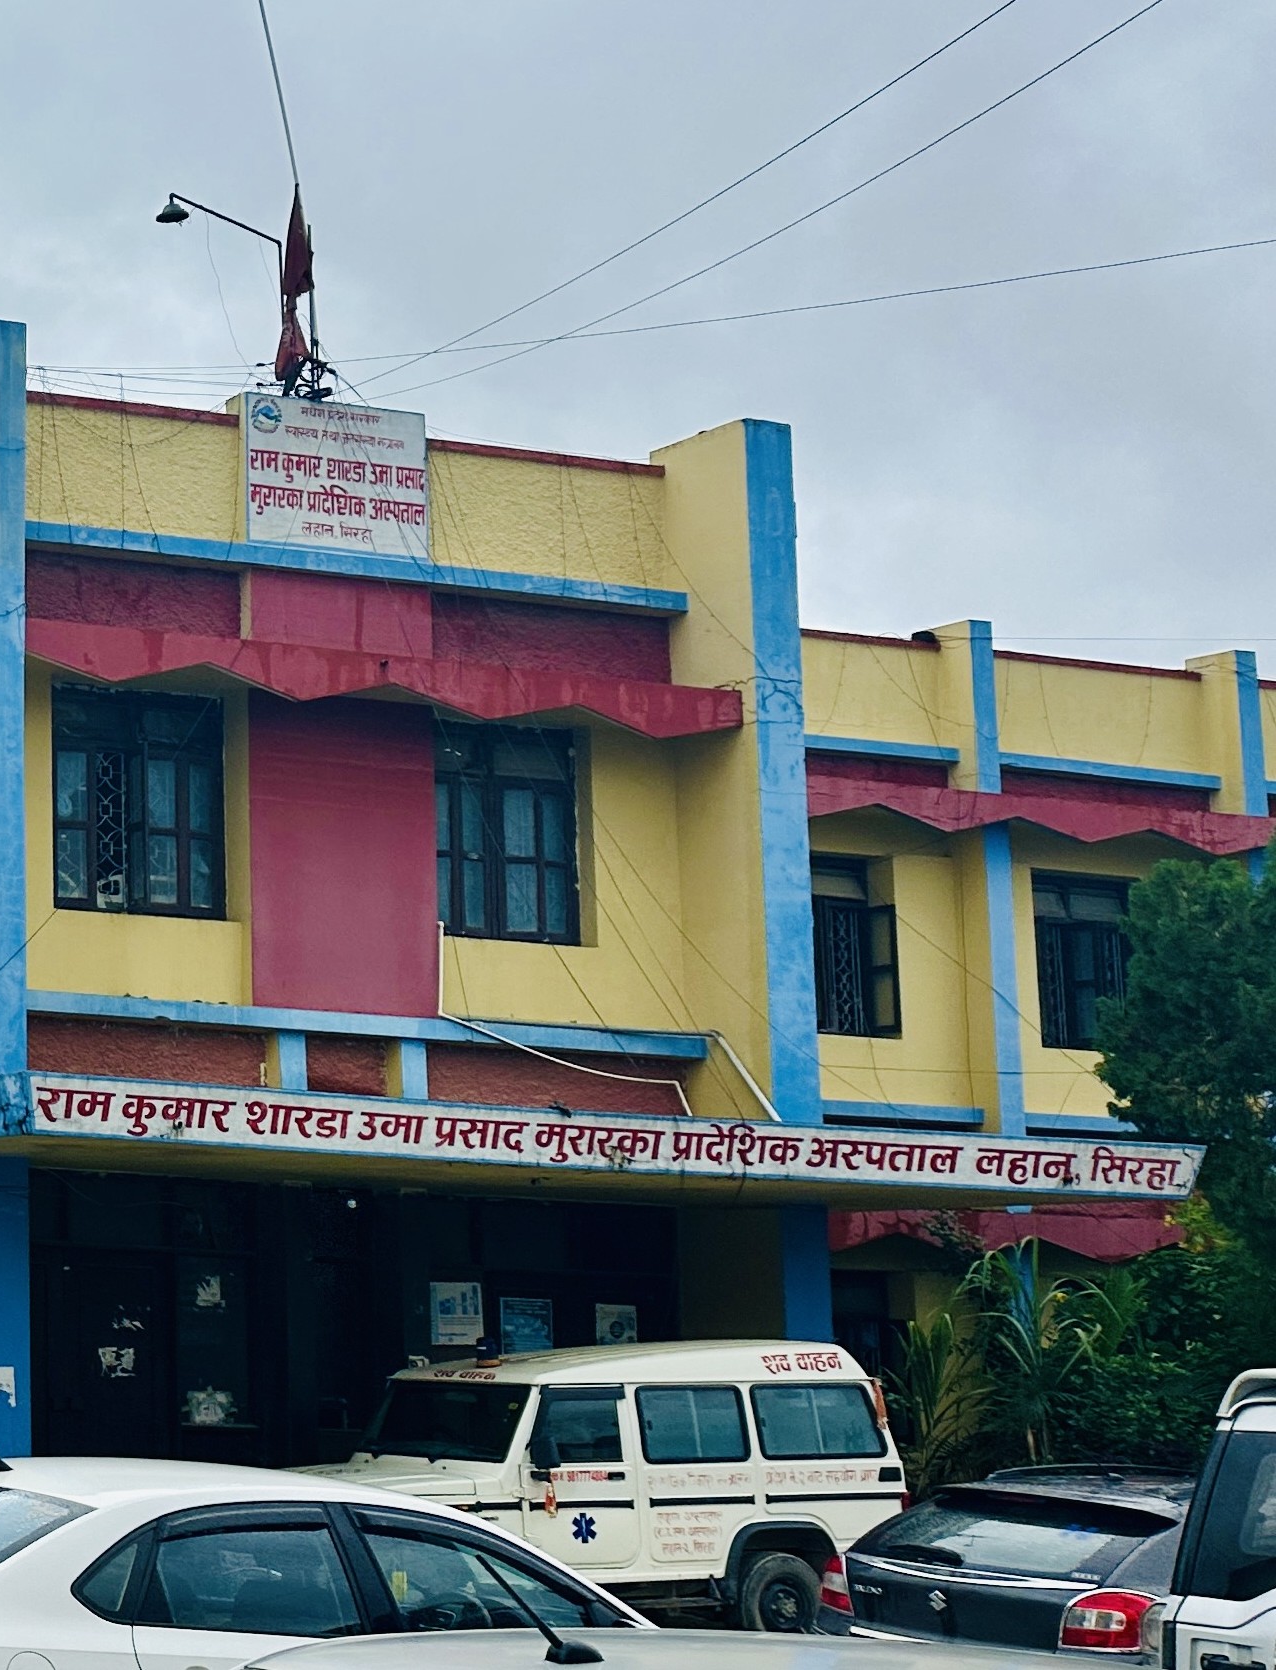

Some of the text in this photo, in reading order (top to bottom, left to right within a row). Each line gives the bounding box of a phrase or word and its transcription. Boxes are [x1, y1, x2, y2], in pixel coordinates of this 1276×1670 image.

[250, 449, 279, 472] राम
[283, 452, 322, 482] कुमार
[369, 463, 393, 487] उमा
[396, 466, 425, 493] प्रसाद
[250, 483, 426, 527] मुरारका प्रादेशिक अस्पताल
[339, 520, 373, 543] सिरहा
[35, 1086, 116, 1123] राम
[122, 1092, 237, 1137] कुमार
[357, 1111, 426, 1145] उमा
[434, 1116, 530, 1155] प्रसाद
[534, 1121, 665, 1162] मुरारका
[673, 1124, 804, 1167] प्रादेशिक
[807, 1138, 964, 1175] अस्पताल
[1090, 1146, 1181, 1191] सिरहा
[761, 1352, 843, 1374] शव वाहन
